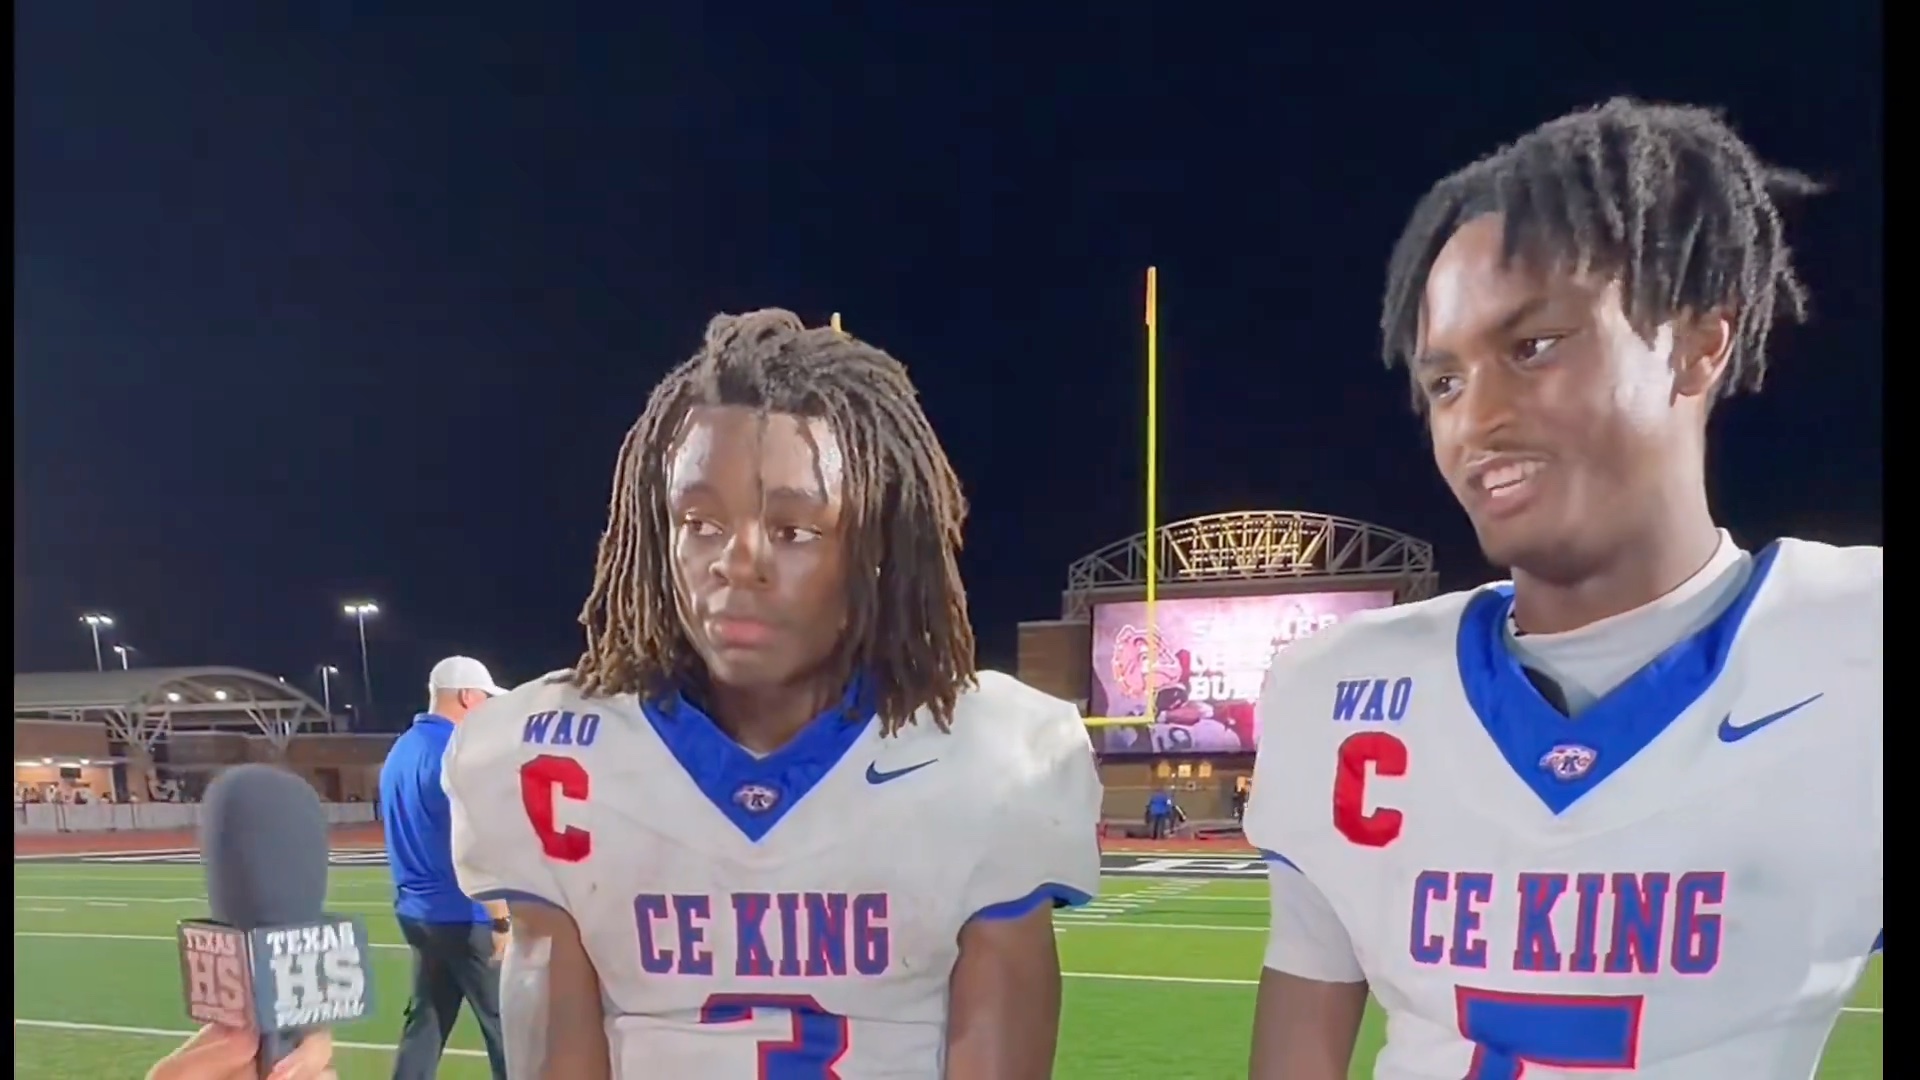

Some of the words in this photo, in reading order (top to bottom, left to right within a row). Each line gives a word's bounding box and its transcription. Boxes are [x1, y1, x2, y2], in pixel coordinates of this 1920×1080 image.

[522, 710, 602, 746] WAO
[1332, 676, 1412, 722] WAO
[520, 754, 591, 862] C
[1333, 731, 1409, 847] C
[634, 894, 714, 975] CE
[732, 893, 890, 977] KING
[1410, 870, 1494, 969] CE
[1513, 871, 1725, 974] KING
[186, 949, 245, 1011] HS
[270, 946, 365, 1009] HS
